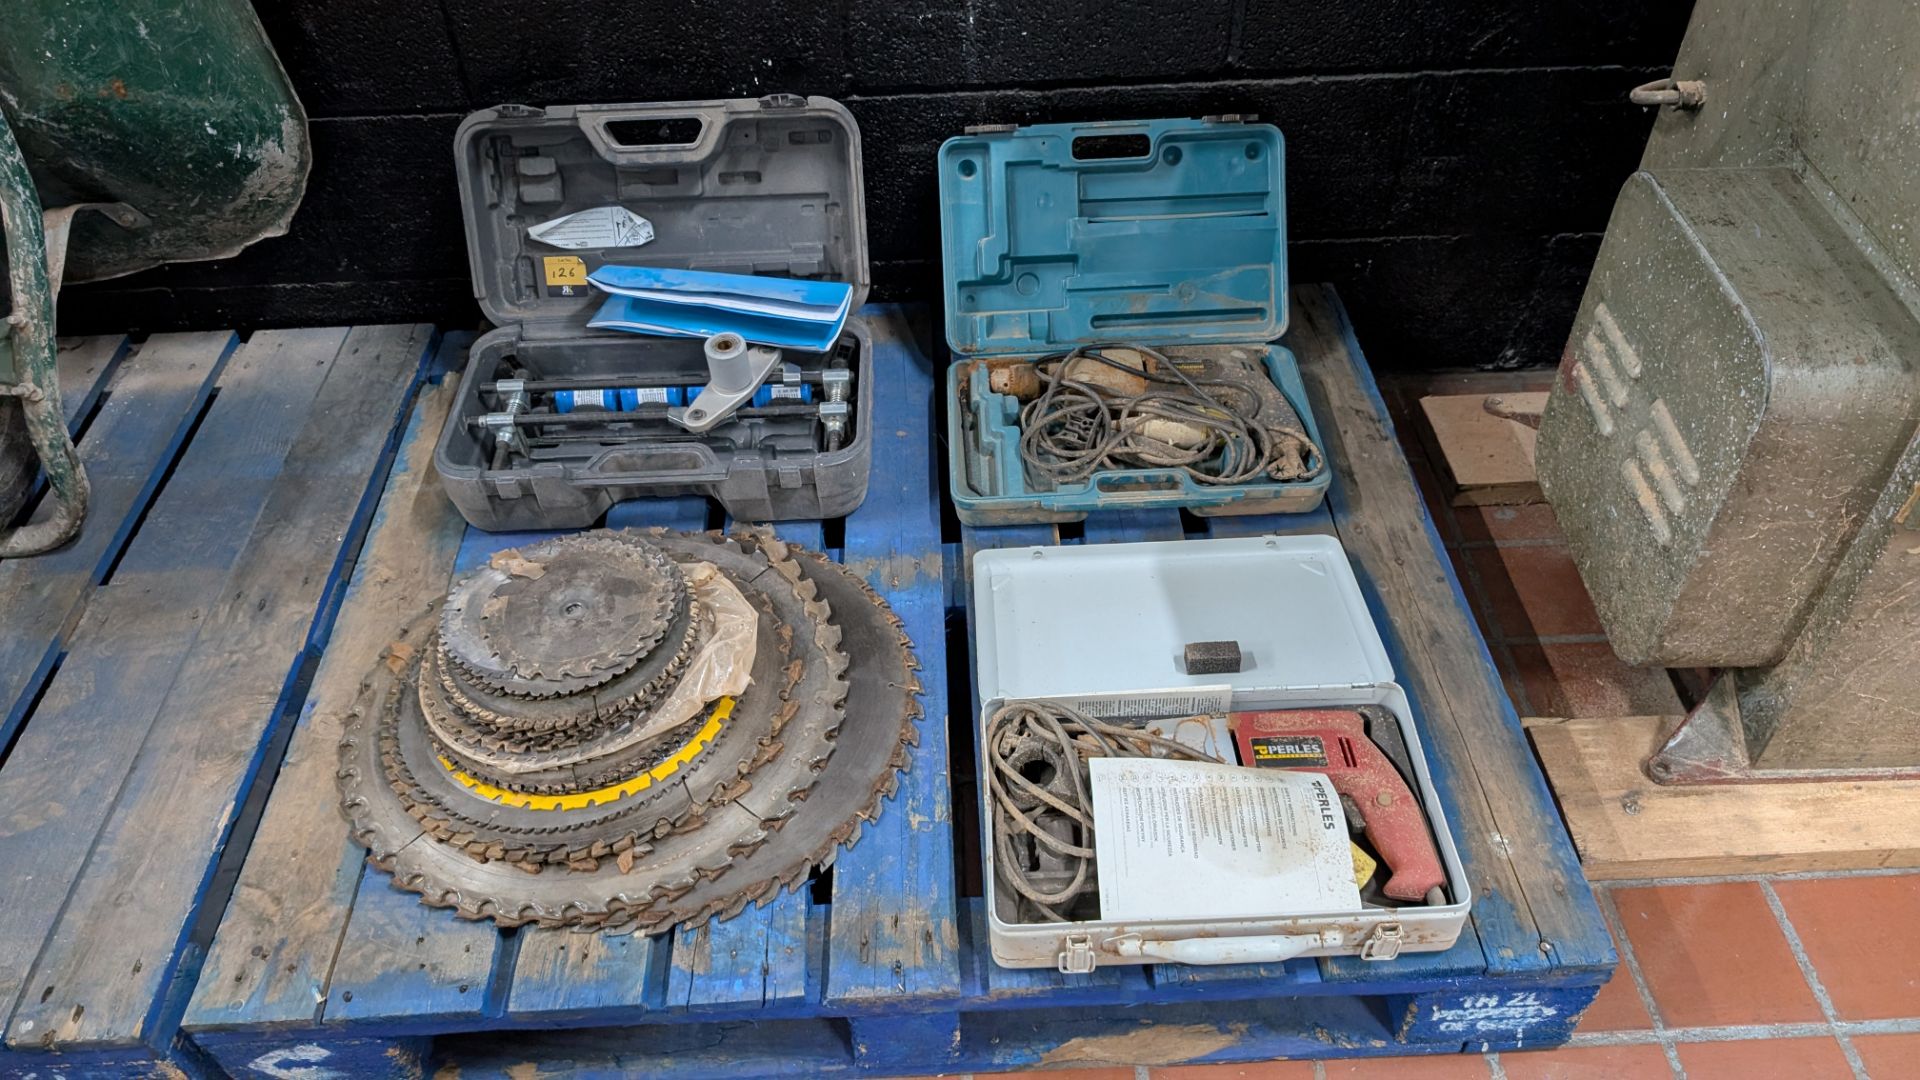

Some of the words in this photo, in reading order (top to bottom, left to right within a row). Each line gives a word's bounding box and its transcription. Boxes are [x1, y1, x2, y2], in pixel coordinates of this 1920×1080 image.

[553, 268, 576, 278] 126
[1268, 744, 1321, 755] PERLES
[1314, 787, 1335, 830] PERLES
